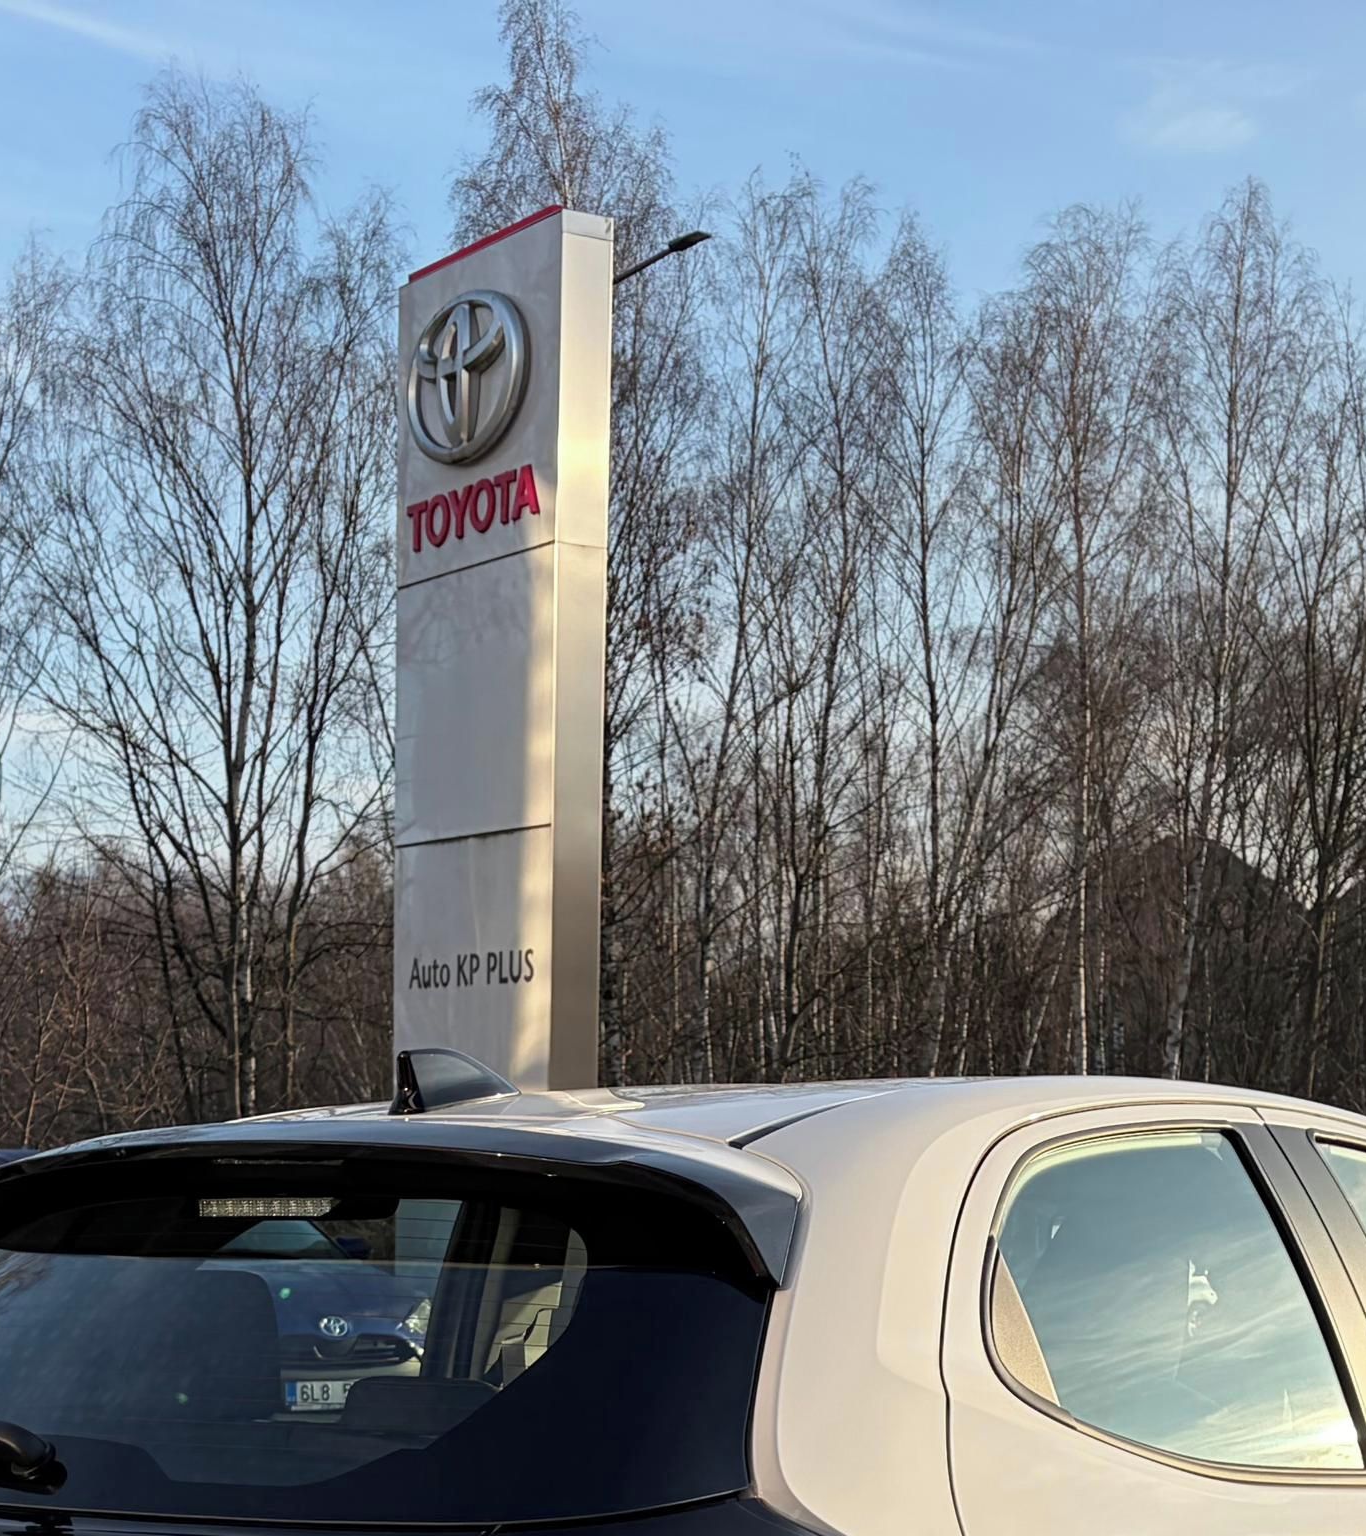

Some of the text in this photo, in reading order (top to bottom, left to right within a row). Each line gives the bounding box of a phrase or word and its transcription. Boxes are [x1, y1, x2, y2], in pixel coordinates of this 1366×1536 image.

[407, 464, 540, 553] TOYOTA
[409, 948, 534, 989] Auto KP PLUS
[300, 1384, 331, 1402] 6L8
